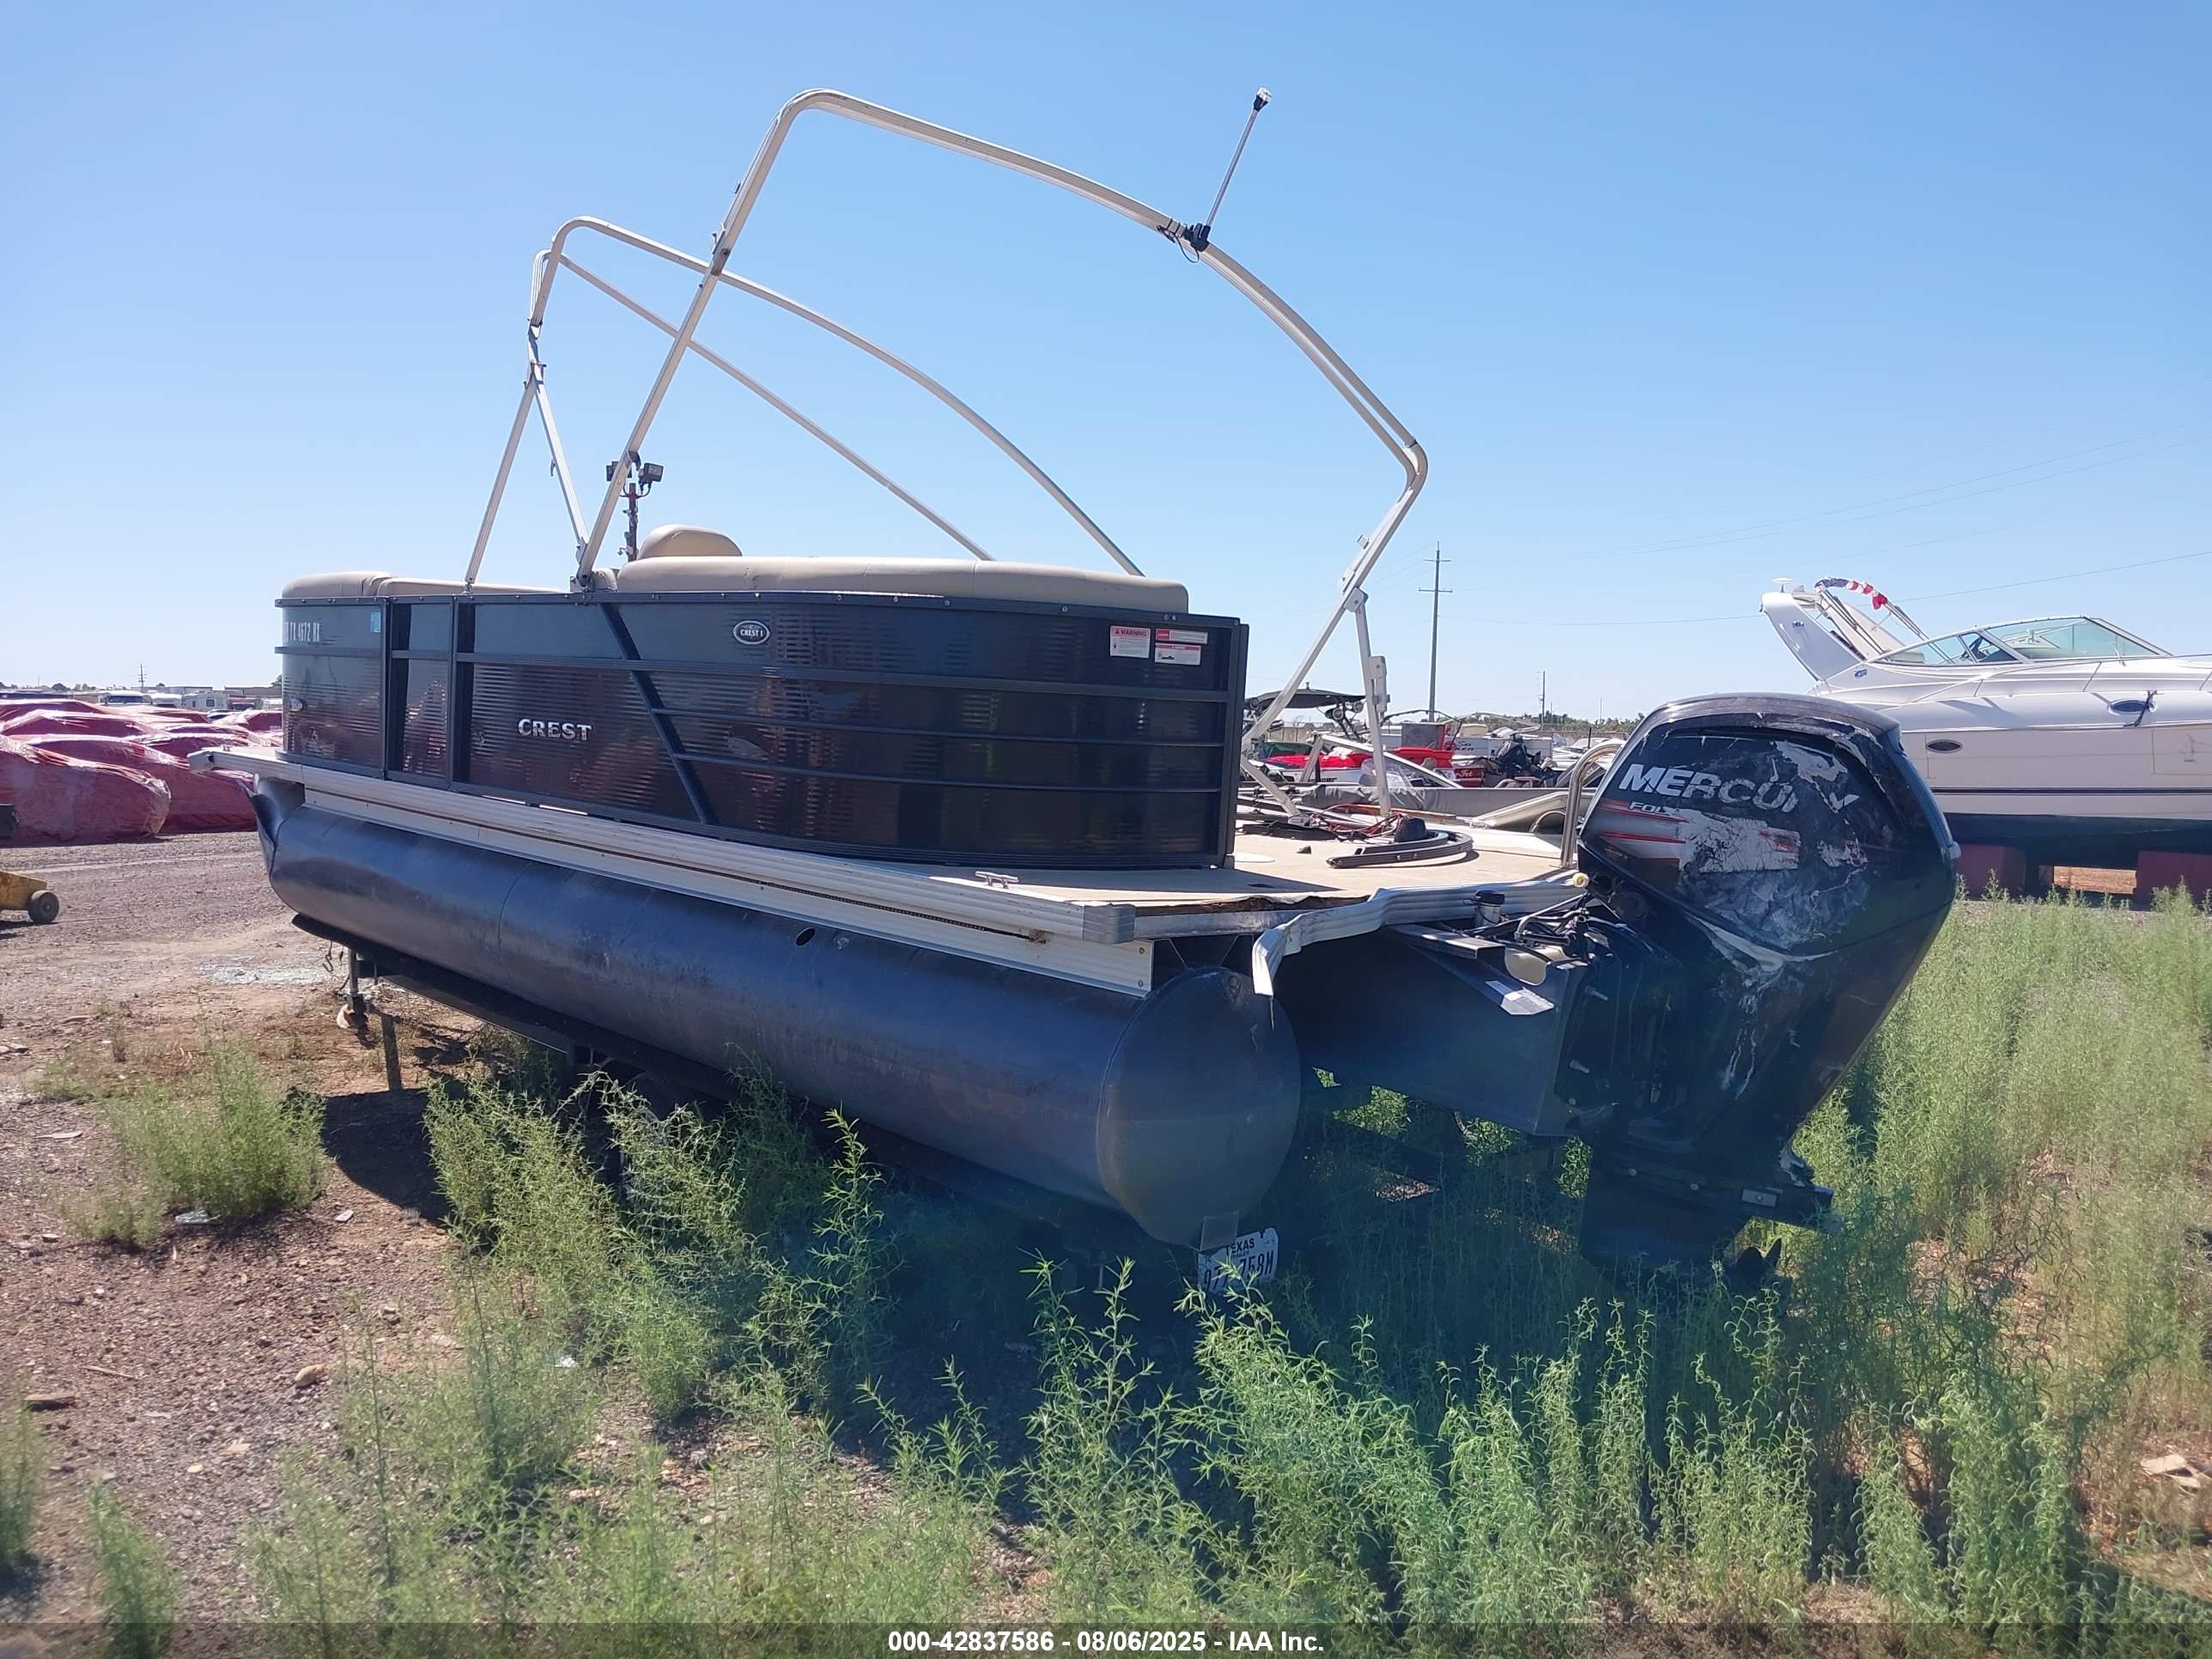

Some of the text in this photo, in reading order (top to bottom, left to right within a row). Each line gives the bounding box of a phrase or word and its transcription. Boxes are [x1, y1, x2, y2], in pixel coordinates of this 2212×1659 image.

[1121, 629, 1147, 637] WARNING
[518, 719, 592, 741] CREST
[1618, 763, 1861, 813] MERCUY
[1225, 1237, 1255, 1255] TEXAS
